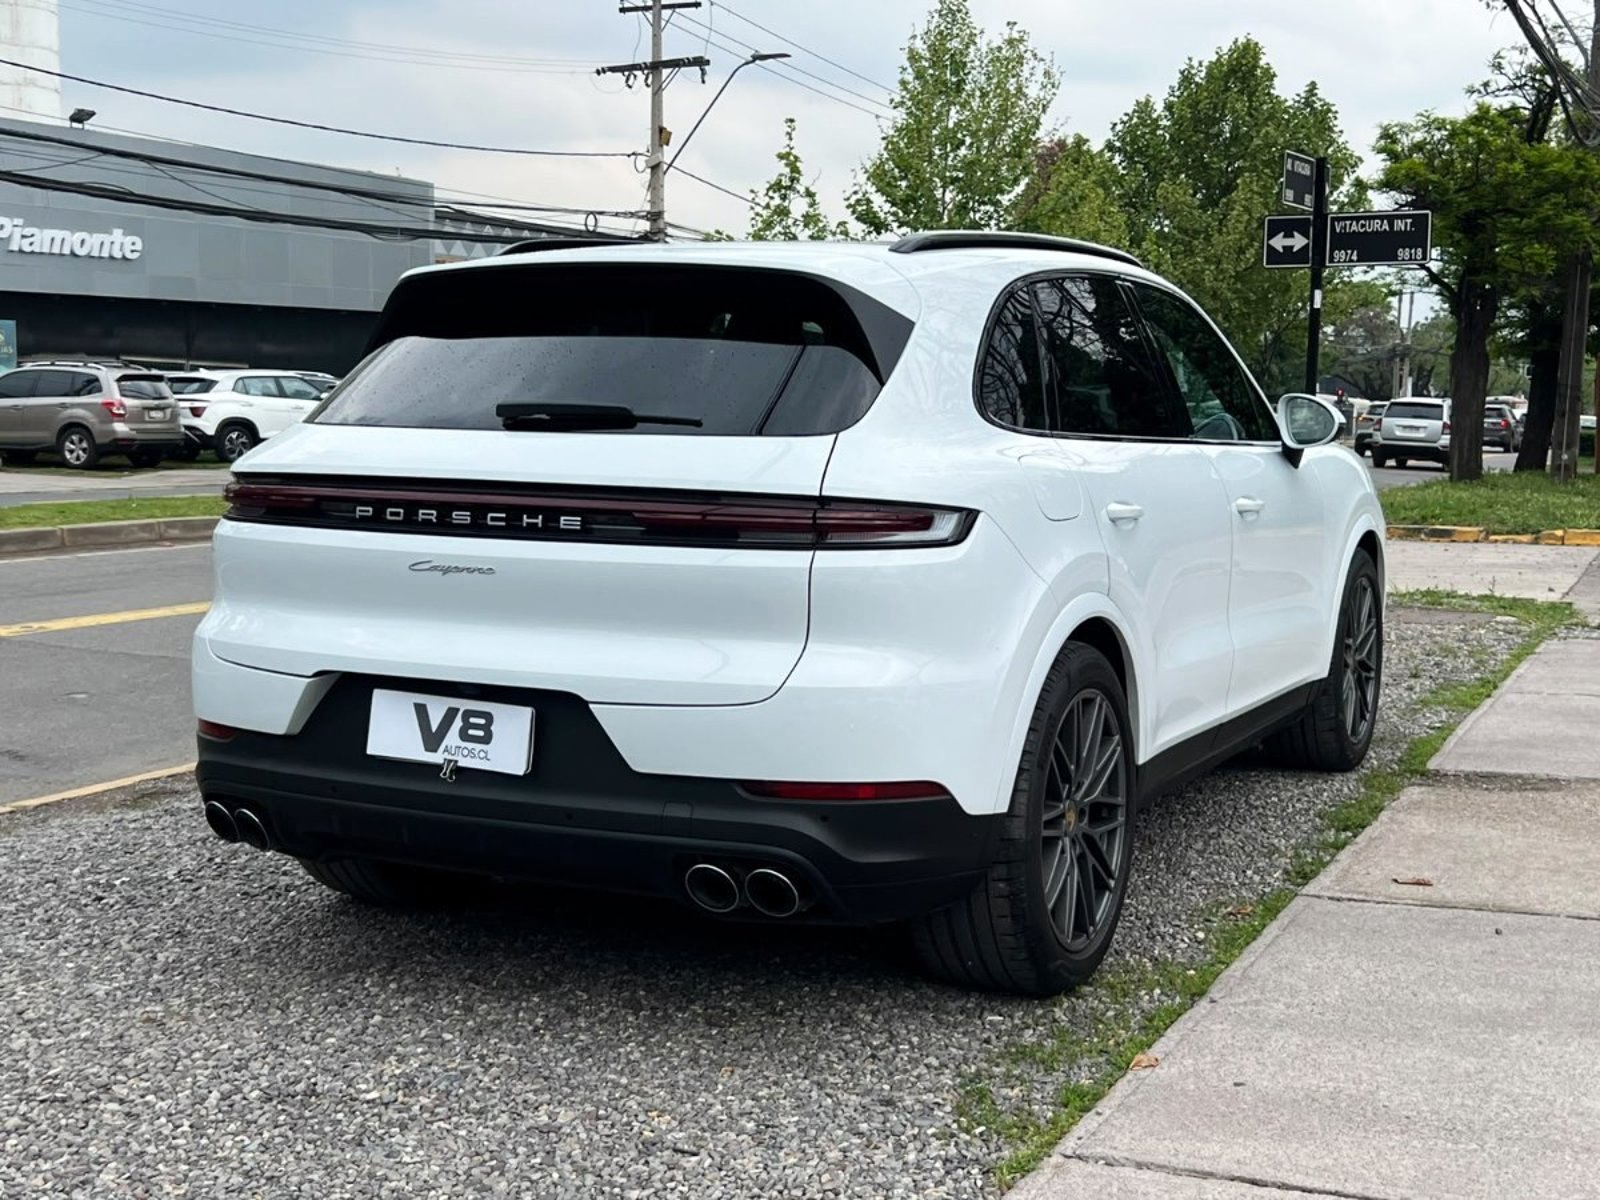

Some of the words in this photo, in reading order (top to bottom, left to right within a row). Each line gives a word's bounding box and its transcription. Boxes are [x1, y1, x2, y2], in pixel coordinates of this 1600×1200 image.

[1334, 219, 1390, 233] VITACURA
[1394, 219, 1416, 232] INT.
[0, 216, 143, 259] Piamonte
[1333, 250, 1358, 262] 9974
[1397, 248, 1423, 261] 9818
[355, 506, 582, 529] PORSCHE
[408, 560, 496, 576] Cayenne
[412, 701, 494, 753] V8
[442, 744, 491, 761] AUTOS.CL
